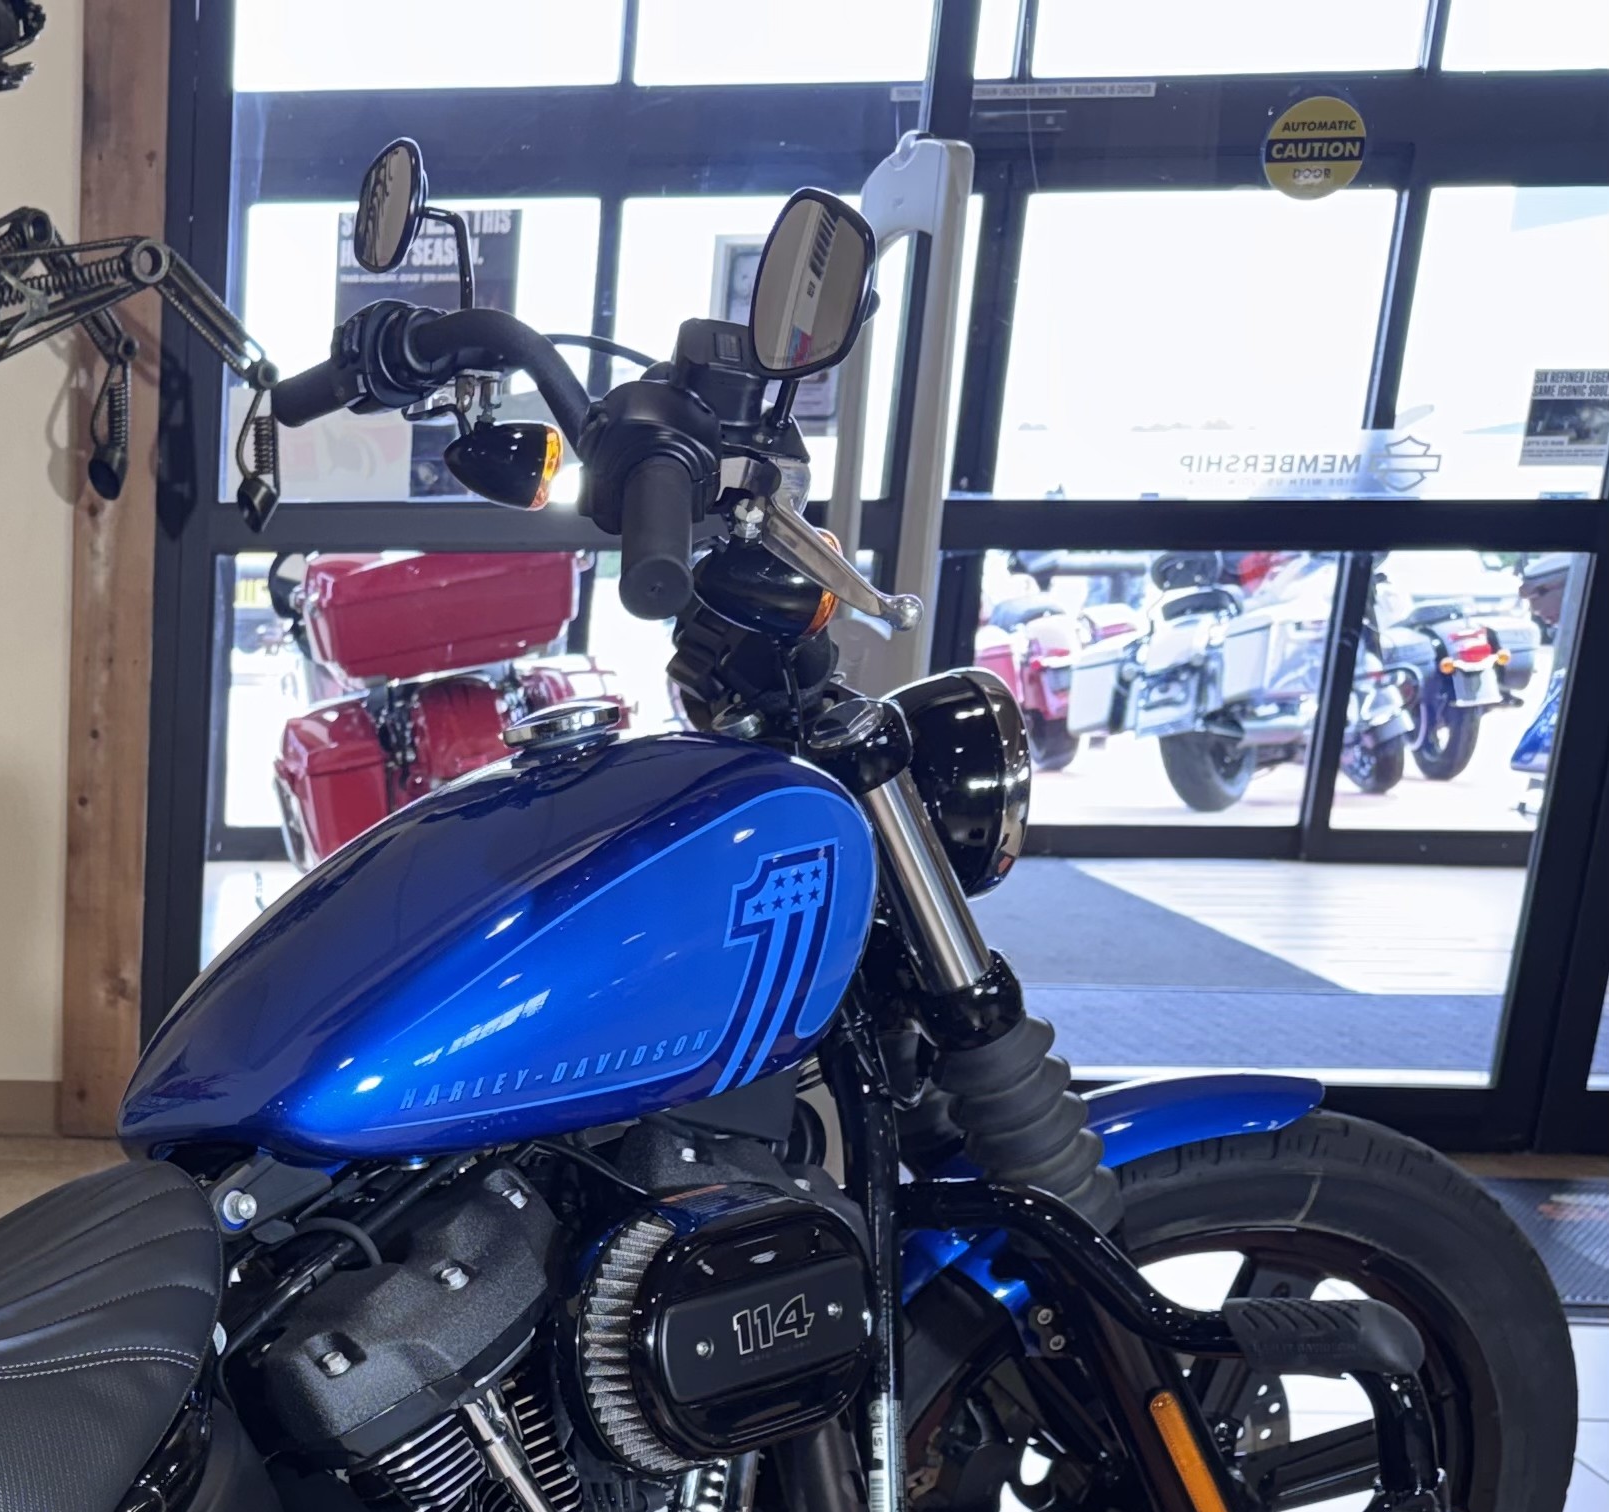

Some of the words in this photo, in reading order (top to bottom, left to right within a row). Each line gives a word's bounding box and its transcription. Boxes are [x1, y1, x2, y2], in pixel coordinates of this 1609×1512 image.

[1282, 120, 1357, 132] AUTOMATIC
[1271, 142, 1361, 159] CAUTION
[399, 1029, 710, 1110] HARLEY-DAVIDSON
[733, 1293, 815, 1355] 114
